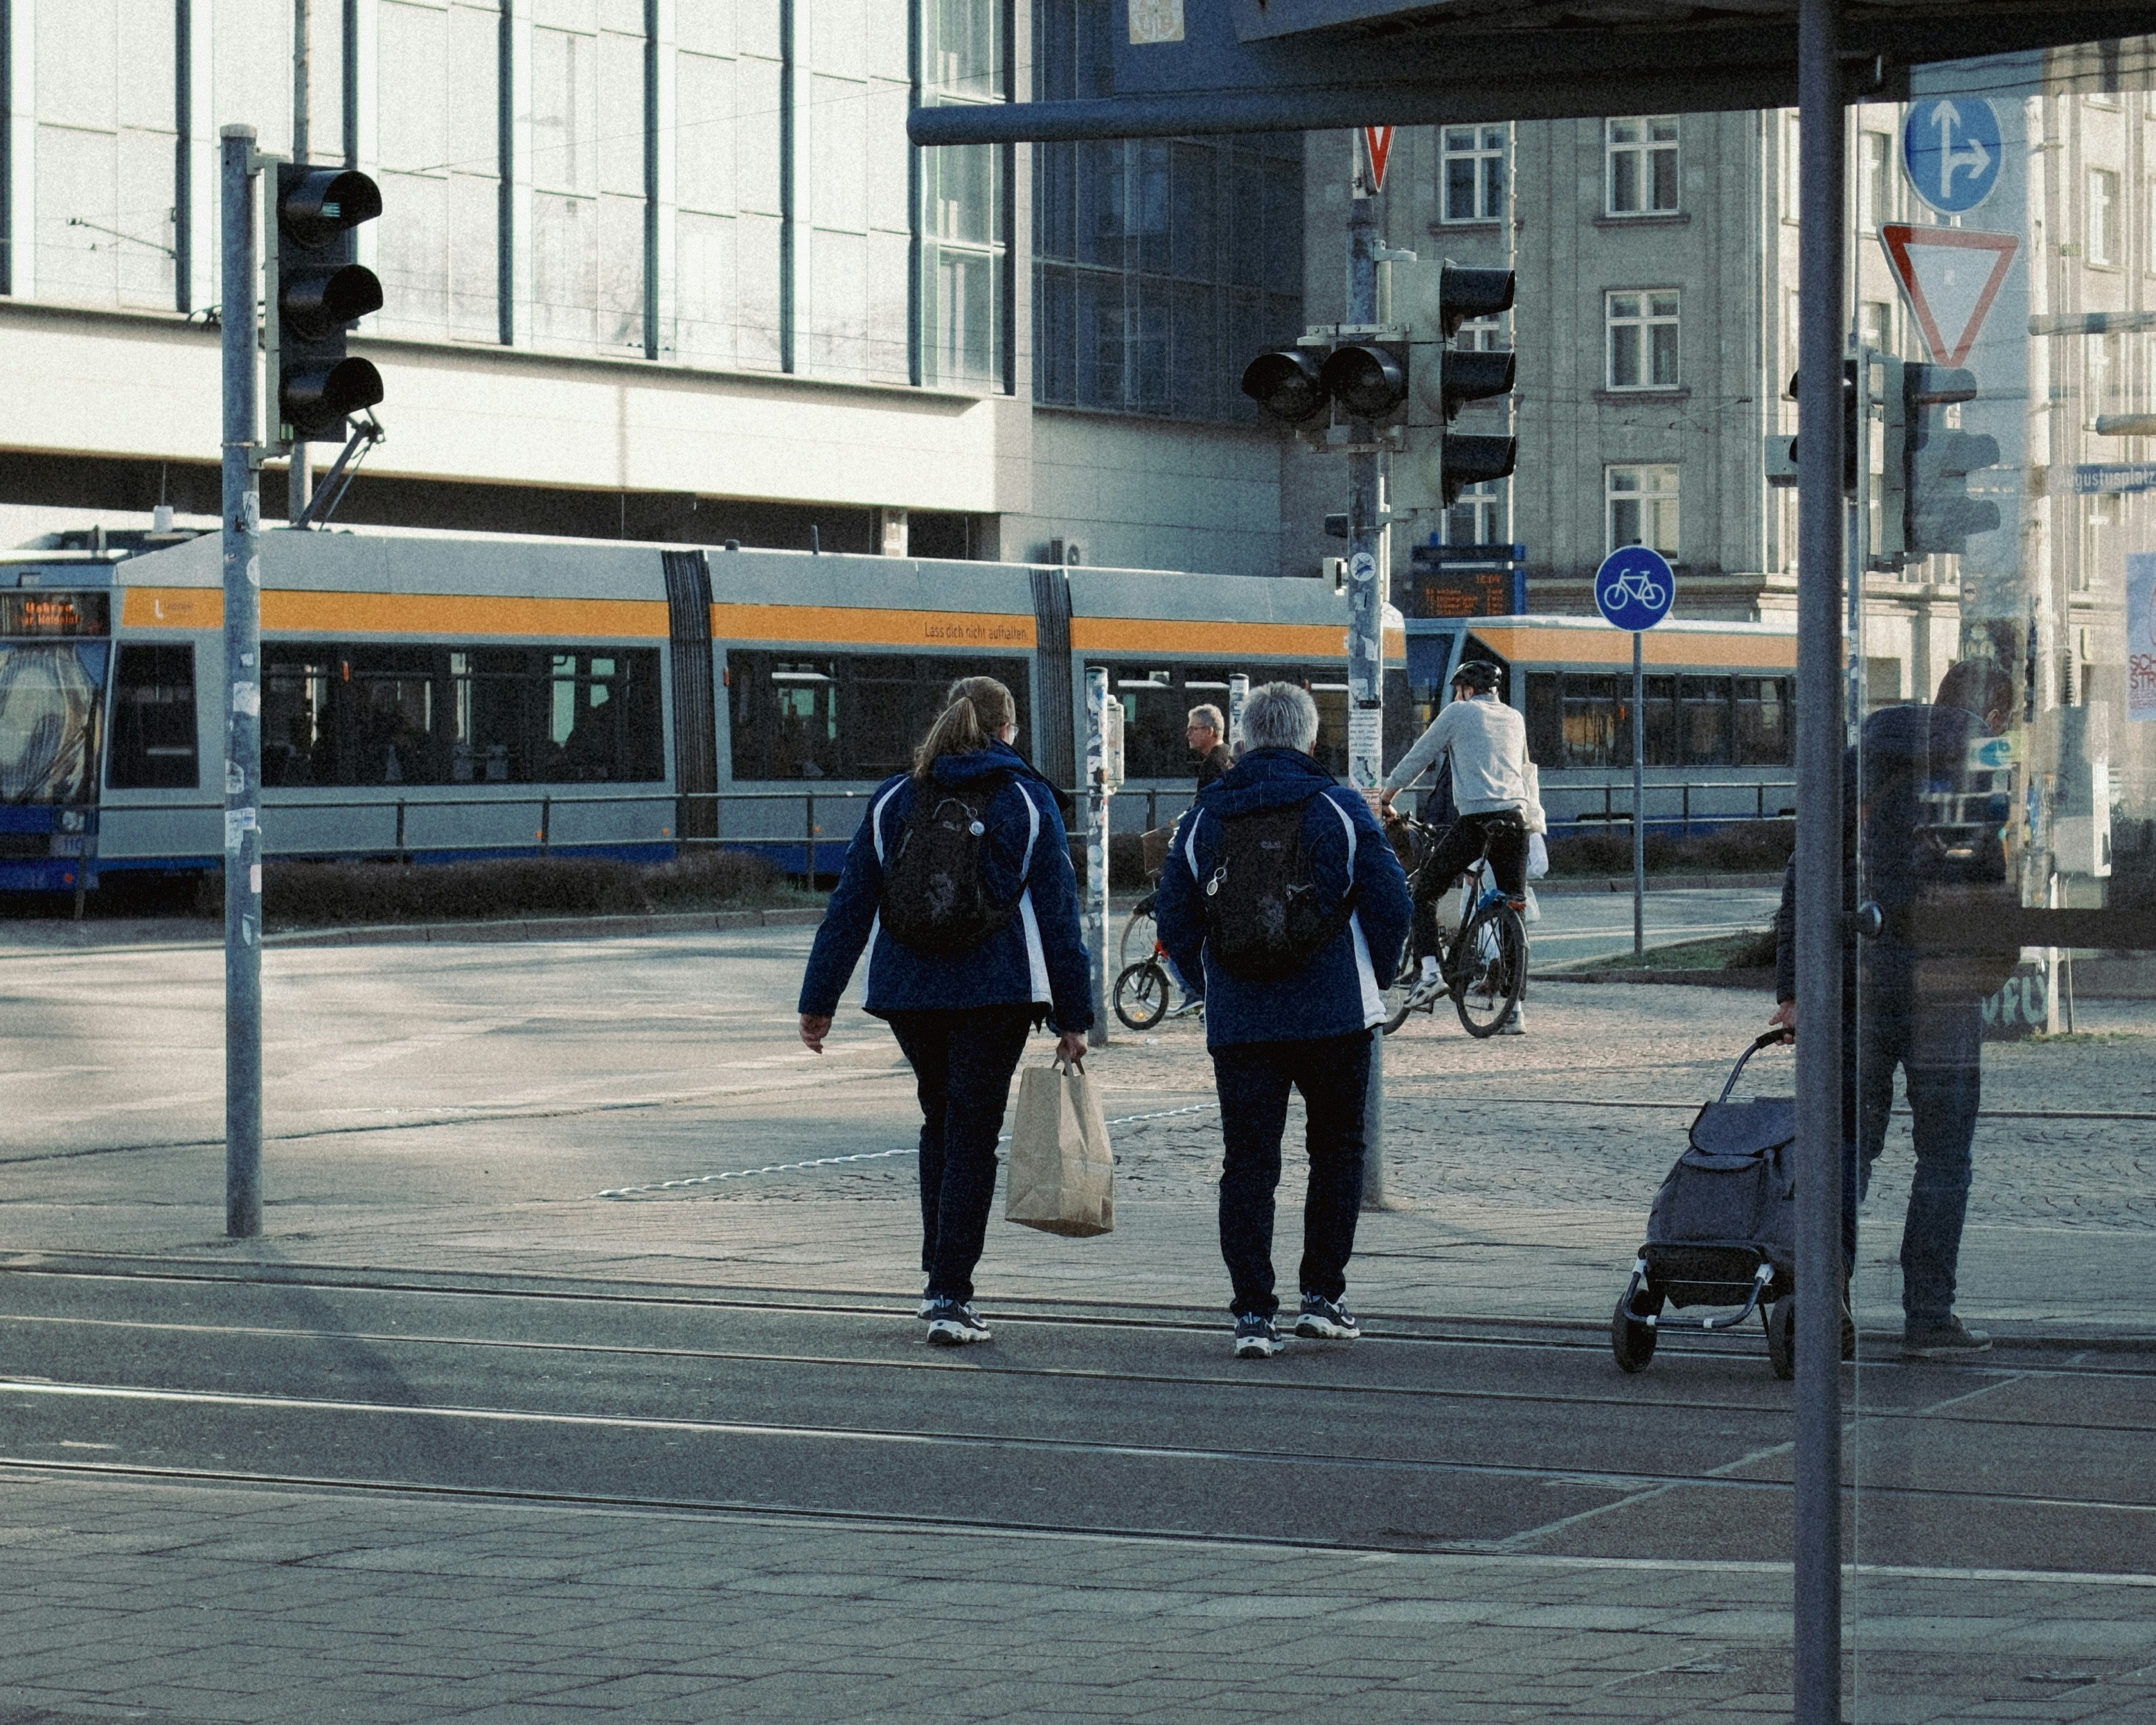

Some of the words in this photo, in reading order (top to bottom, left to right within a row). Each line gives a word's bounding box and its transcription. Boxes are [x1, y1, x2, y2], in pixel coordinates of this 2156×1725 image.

[2057, 467, 2156, 492] Augustusplatz
[924, 621, 944, 638] Lass
[946, 625, 963, 638] dich
[965, 626, 986, 639] nicht
